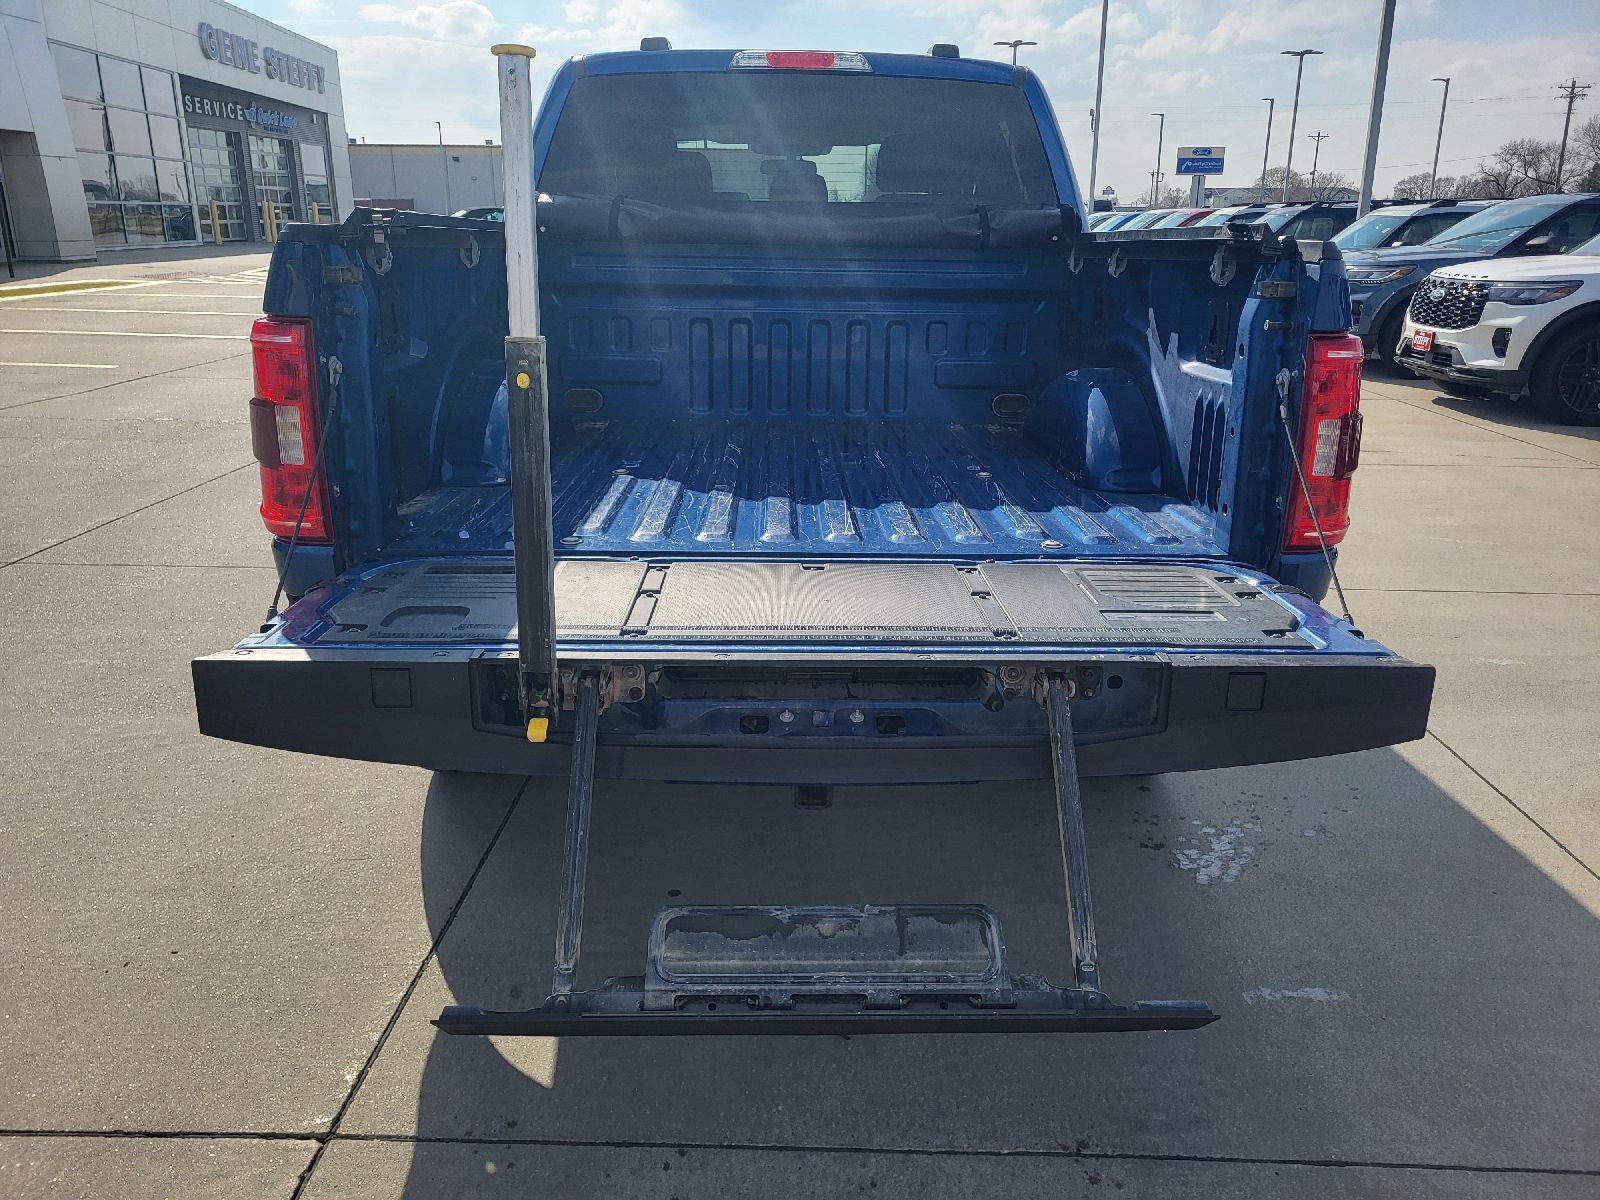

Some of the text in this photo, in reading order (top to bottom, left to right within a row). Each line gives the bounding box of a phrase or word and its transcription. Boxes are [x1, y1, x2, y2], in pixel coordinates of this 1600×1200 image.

[200, 22, 325, 94] GENE STEFFY
[185, 95, 244, 121] SERVICE
